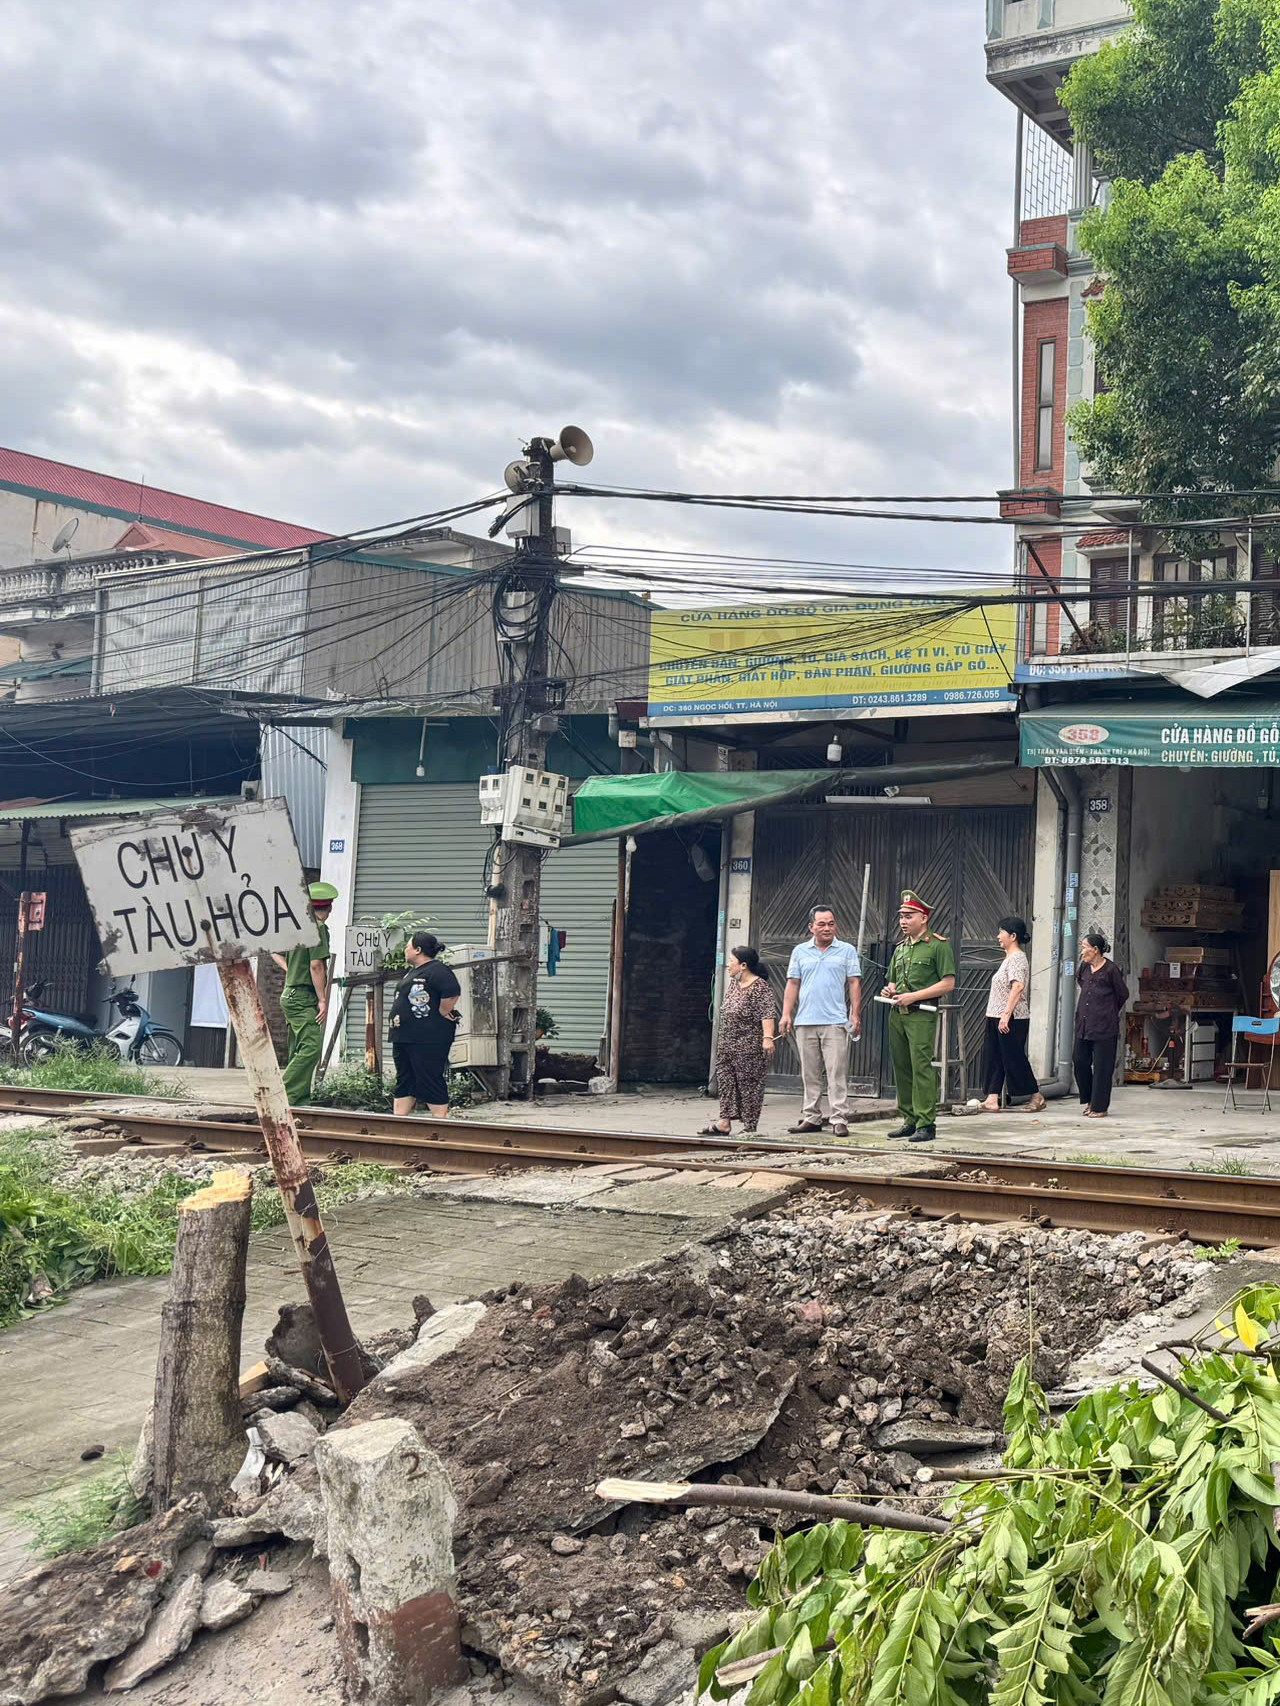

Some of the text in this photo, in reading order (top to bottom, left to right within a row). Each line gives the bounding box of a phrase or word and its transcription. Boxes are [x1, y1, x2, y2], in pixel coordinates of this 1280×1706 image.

[917, 648, 928, 657] TI
[694, 703, 717, 713] NGỌC
[763, 700, 778, 709] NỘI
[1067, 729, 1100, 741] 358
[1161, 723, 1189, 744] CỬA
[1194, 725, 1232, 744] HÀNG
[1237, 722, 1256, 744] ĐỒ
[1260, 722, 1279, 744] GỖ
[1161, 748, 1208, 762] CHUYÊN:
[1263, 747, 1280, 763] TỦ,
[1090, 800, 1107, 811] 358
[733, 860, 749, 871] 360
[113, 873, 302, 954] TÀU HỎA
[357, 930, 391, 947] CHÚ Ý
[350, 949, 373, 966] TÀU
